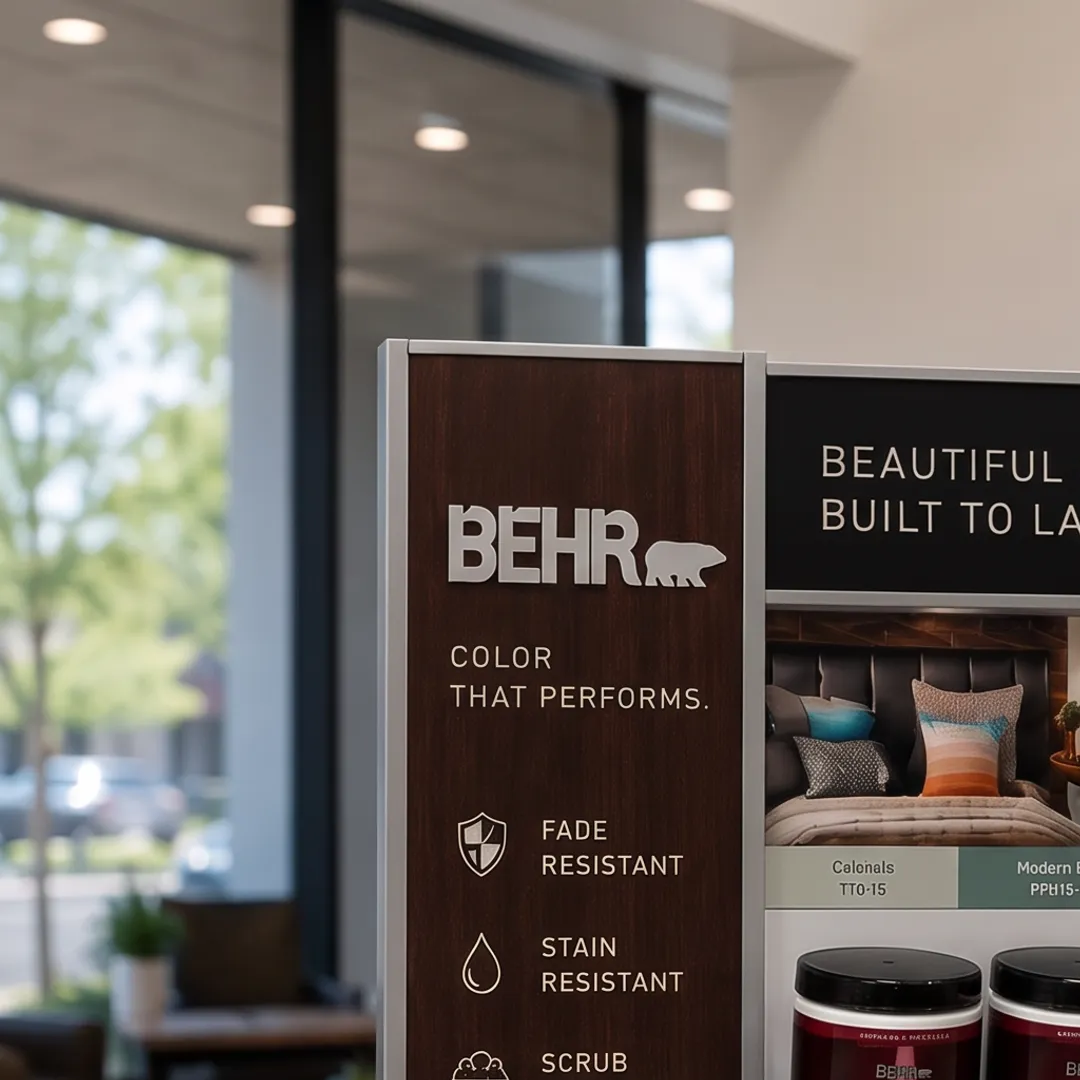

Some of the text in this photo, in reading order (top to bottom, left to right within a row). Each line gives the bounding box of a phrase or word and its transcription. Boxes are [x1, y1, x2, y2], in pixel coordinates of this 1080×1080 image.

[822, 445, 1063, 483] BEAUTIFUL
[822, 498, 942, 533] BUILT
[960, 501, 1012, 535] TO
[449, 504, 642, 586] BEHR
[450, 645, 551, 669] COLOR
[450, 684, 709, 710] THAT PERFORMS.
[542, 820, 607, 840] FADE
[542, 855, 684, 875] RESISTANT
[1017, 861, 1071, 875] Modern
[542, 937, 616, 957] STAIN
[542, 971, 684, 992] RESISTANT
[542, 1052, 628, 1073] SCRUB
